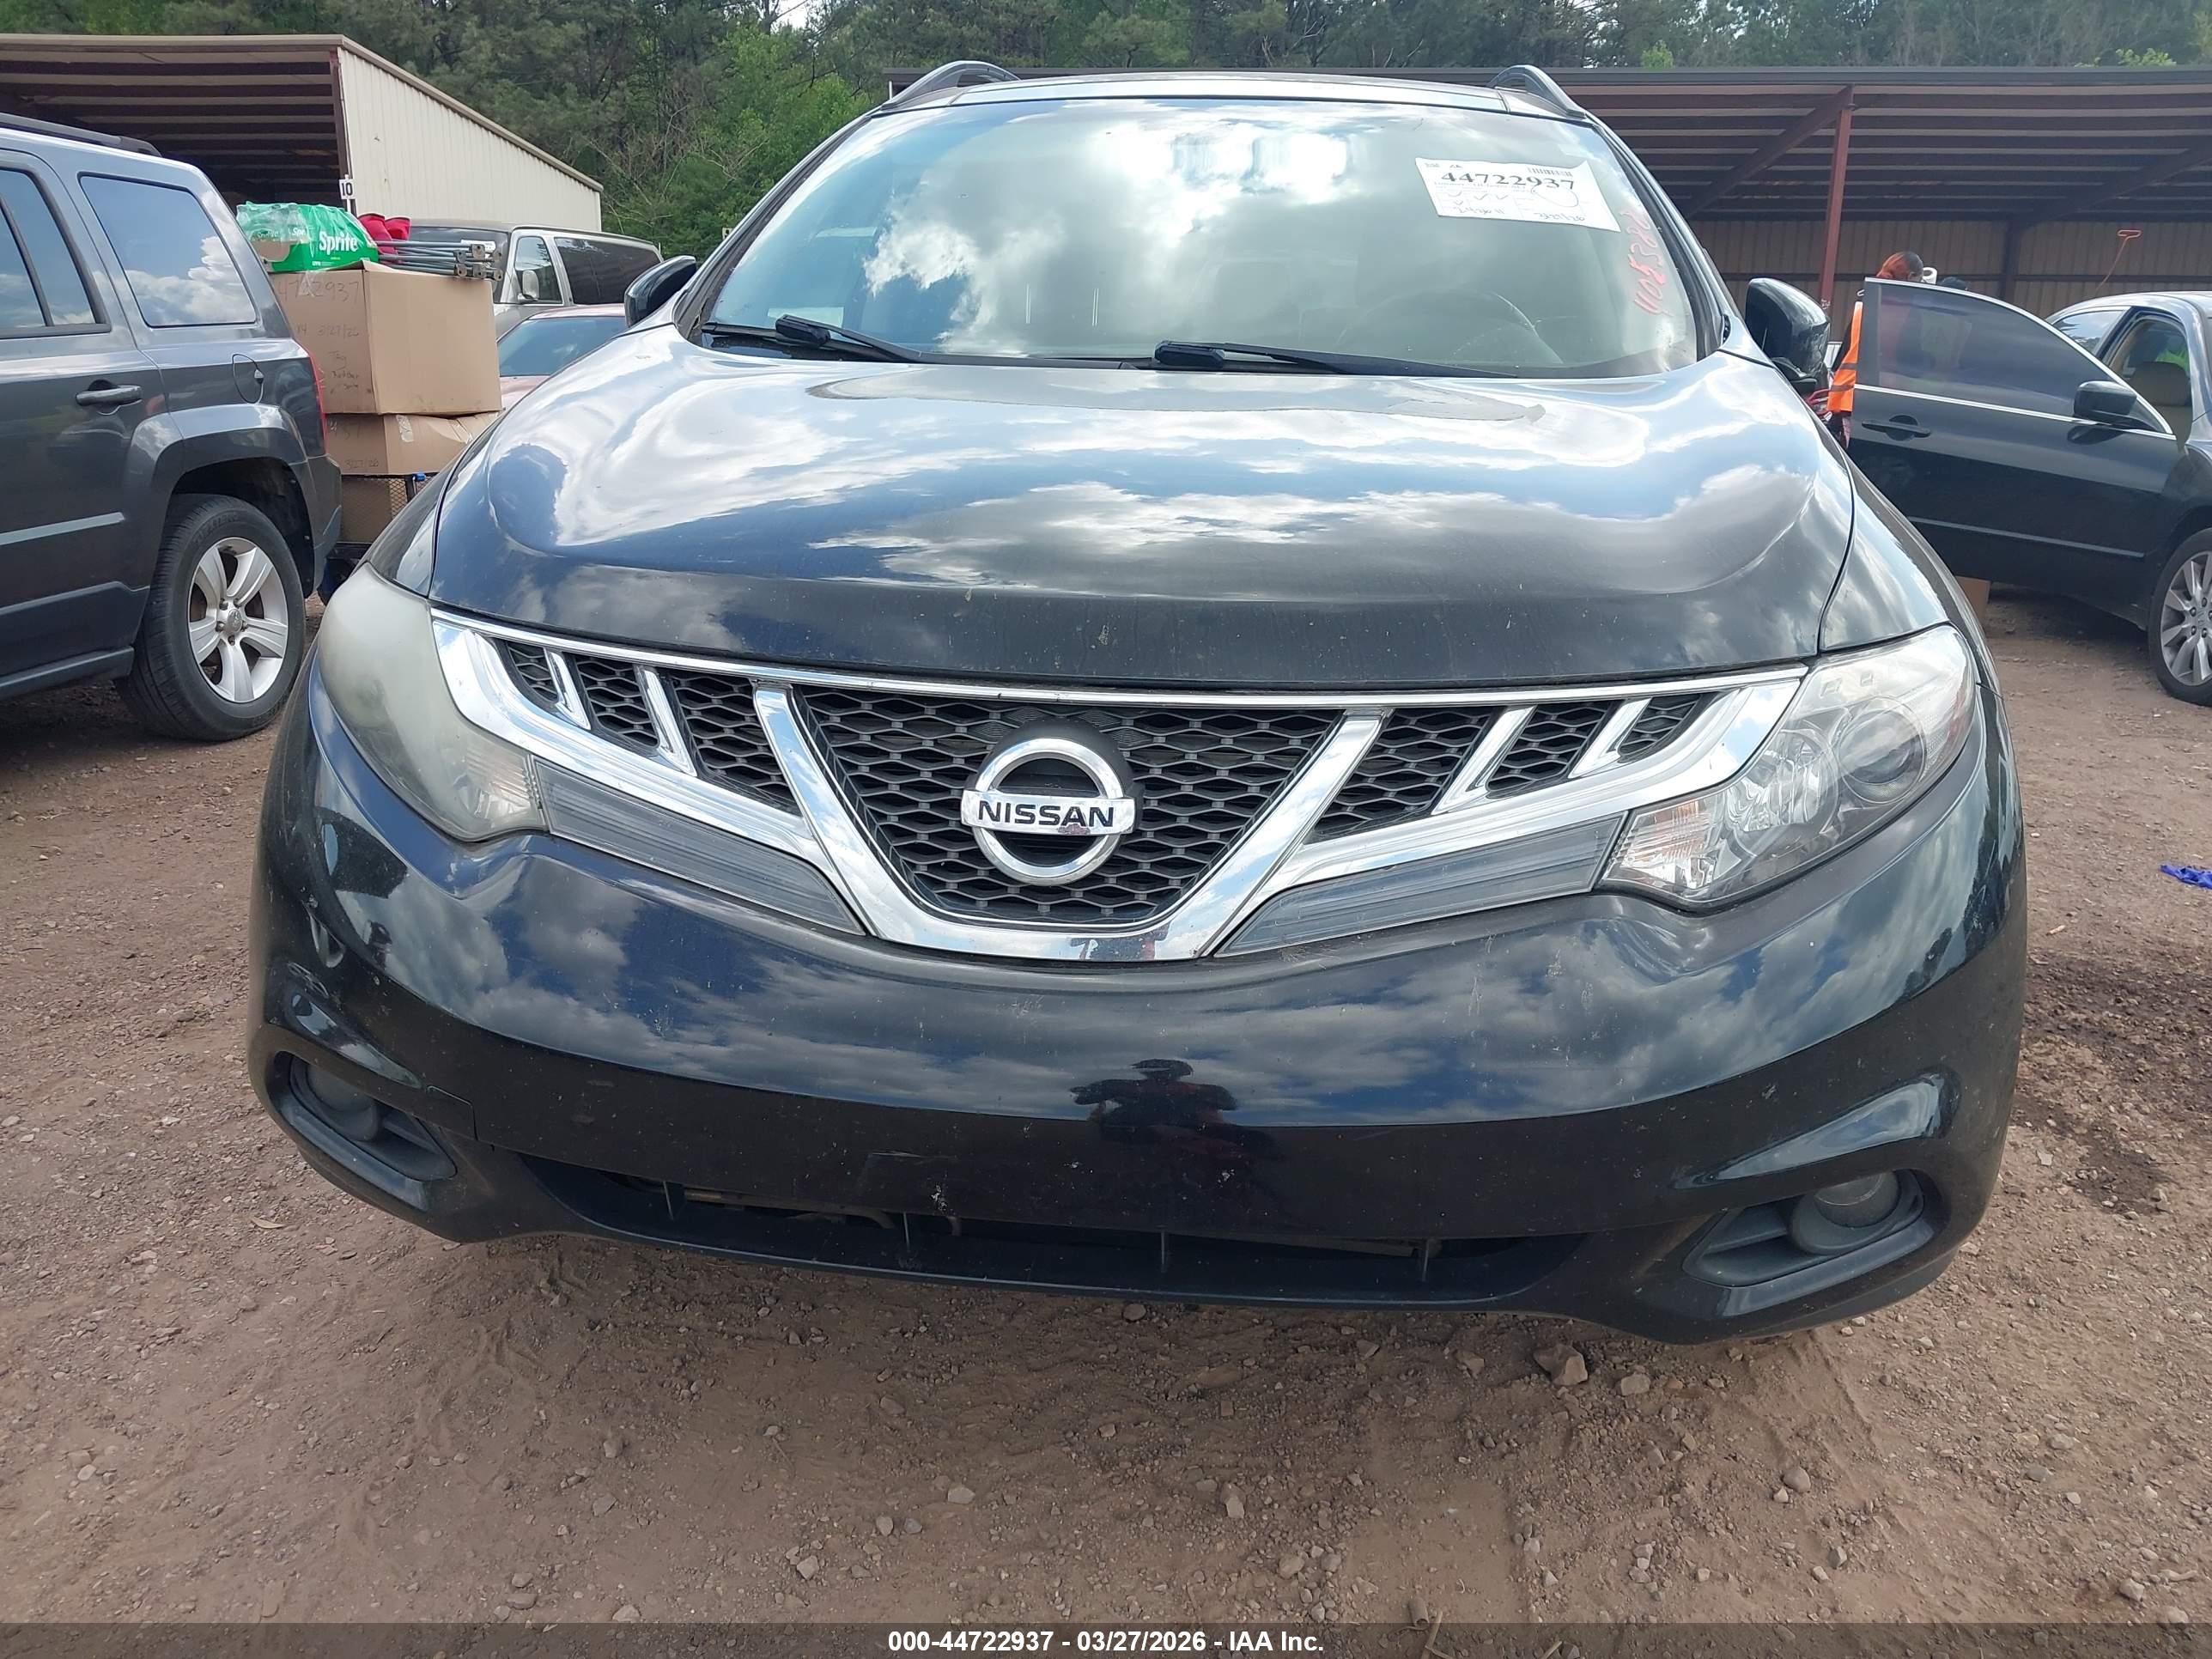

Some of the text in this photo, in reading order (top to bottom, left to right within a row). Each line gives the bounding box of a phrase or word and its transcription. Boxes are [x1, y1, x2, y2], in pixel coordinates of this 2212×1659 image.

[341, 182, 353, 196] 10
[1441, 172, 1574, 190] 44722937
[319, 230, 358, 256] Sprite
[978, 800, 1114, 828] NISSAN
